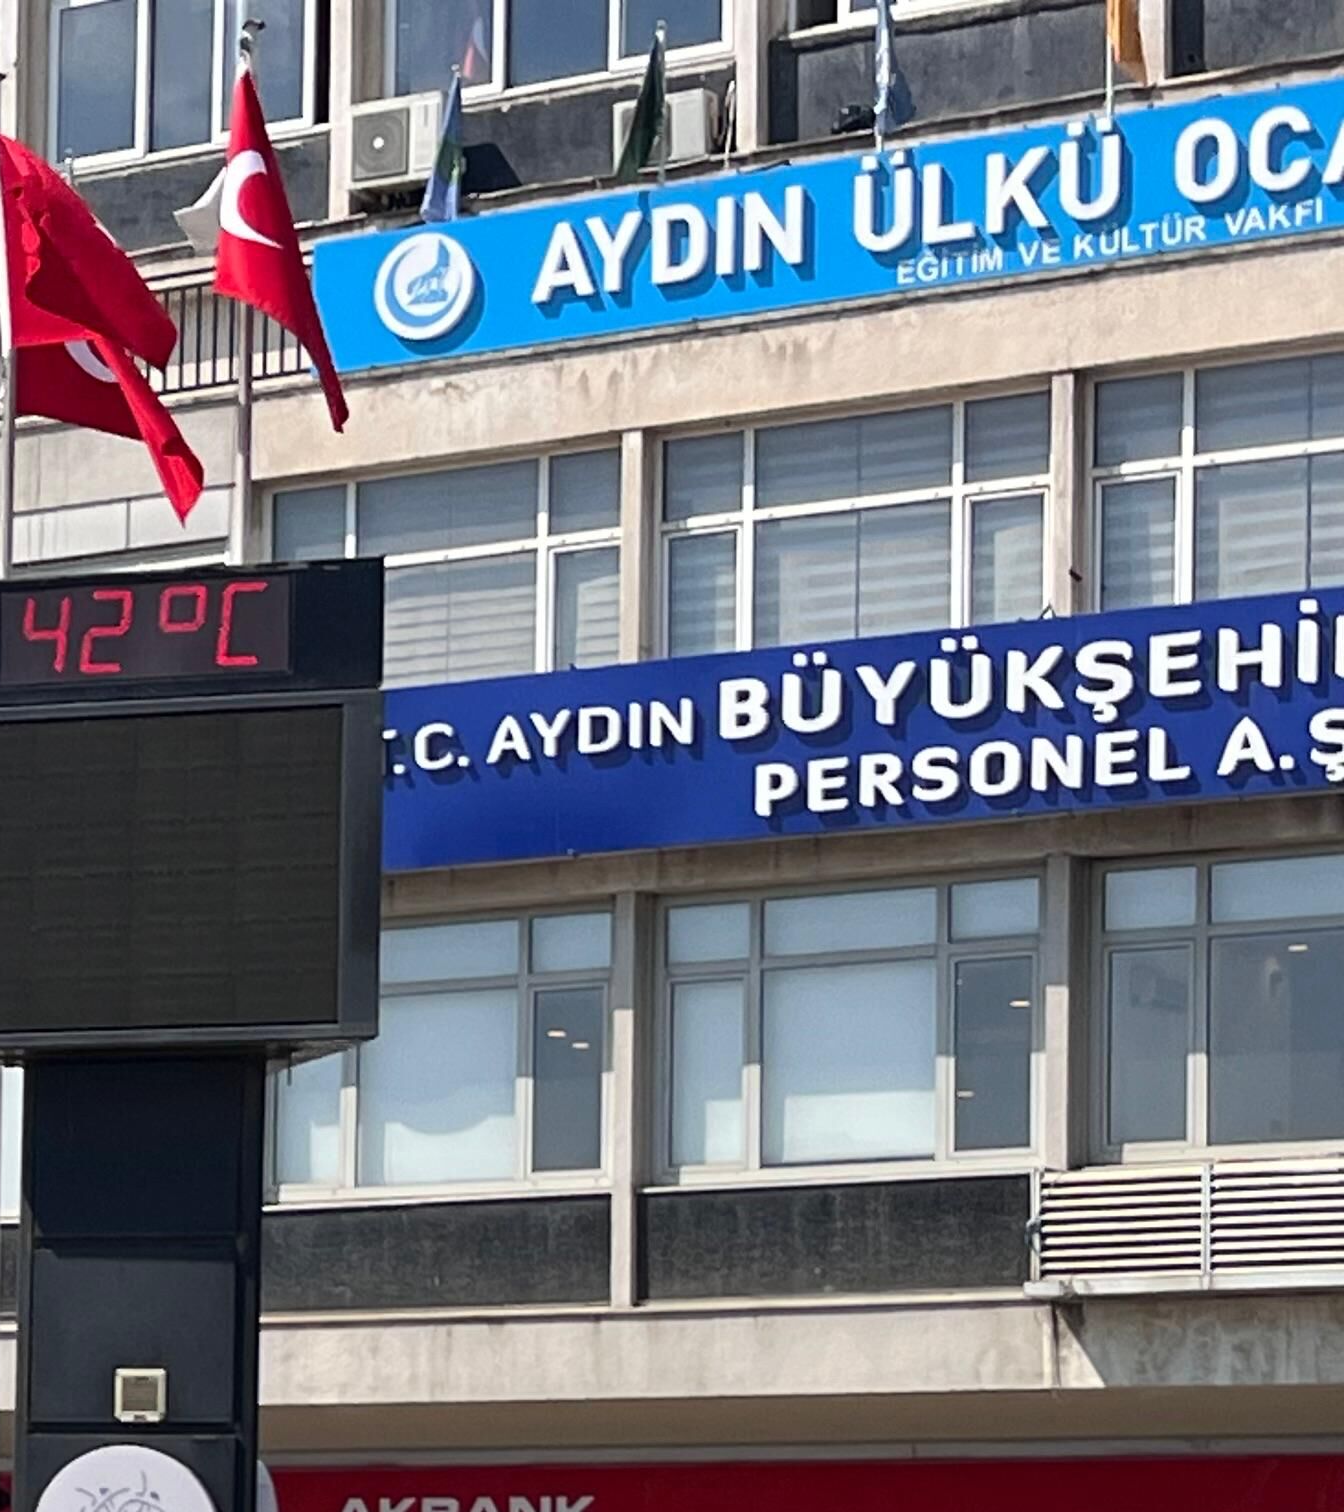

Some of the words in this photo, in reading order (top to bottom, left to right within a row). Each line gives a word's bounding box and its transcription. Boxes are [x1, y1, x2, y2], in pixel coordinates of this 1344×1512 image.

[530, 184, 805, 305] AYDIN
[853, 119, 1122, 254] ÜLKÜ
[1020, 239, 1062, 267] VE
[1074, 214, 1207, 262] KÜLTÜR
[1224, 196, 1324, 237] VAKFI
[382, 722, 471, 775] .C.
[486, 697, 694, 766] AYDIN
[718, 598, 1344, 741] BÜYÜKŞEHİ
[754, 726, 1191, 817] PERSONEL
